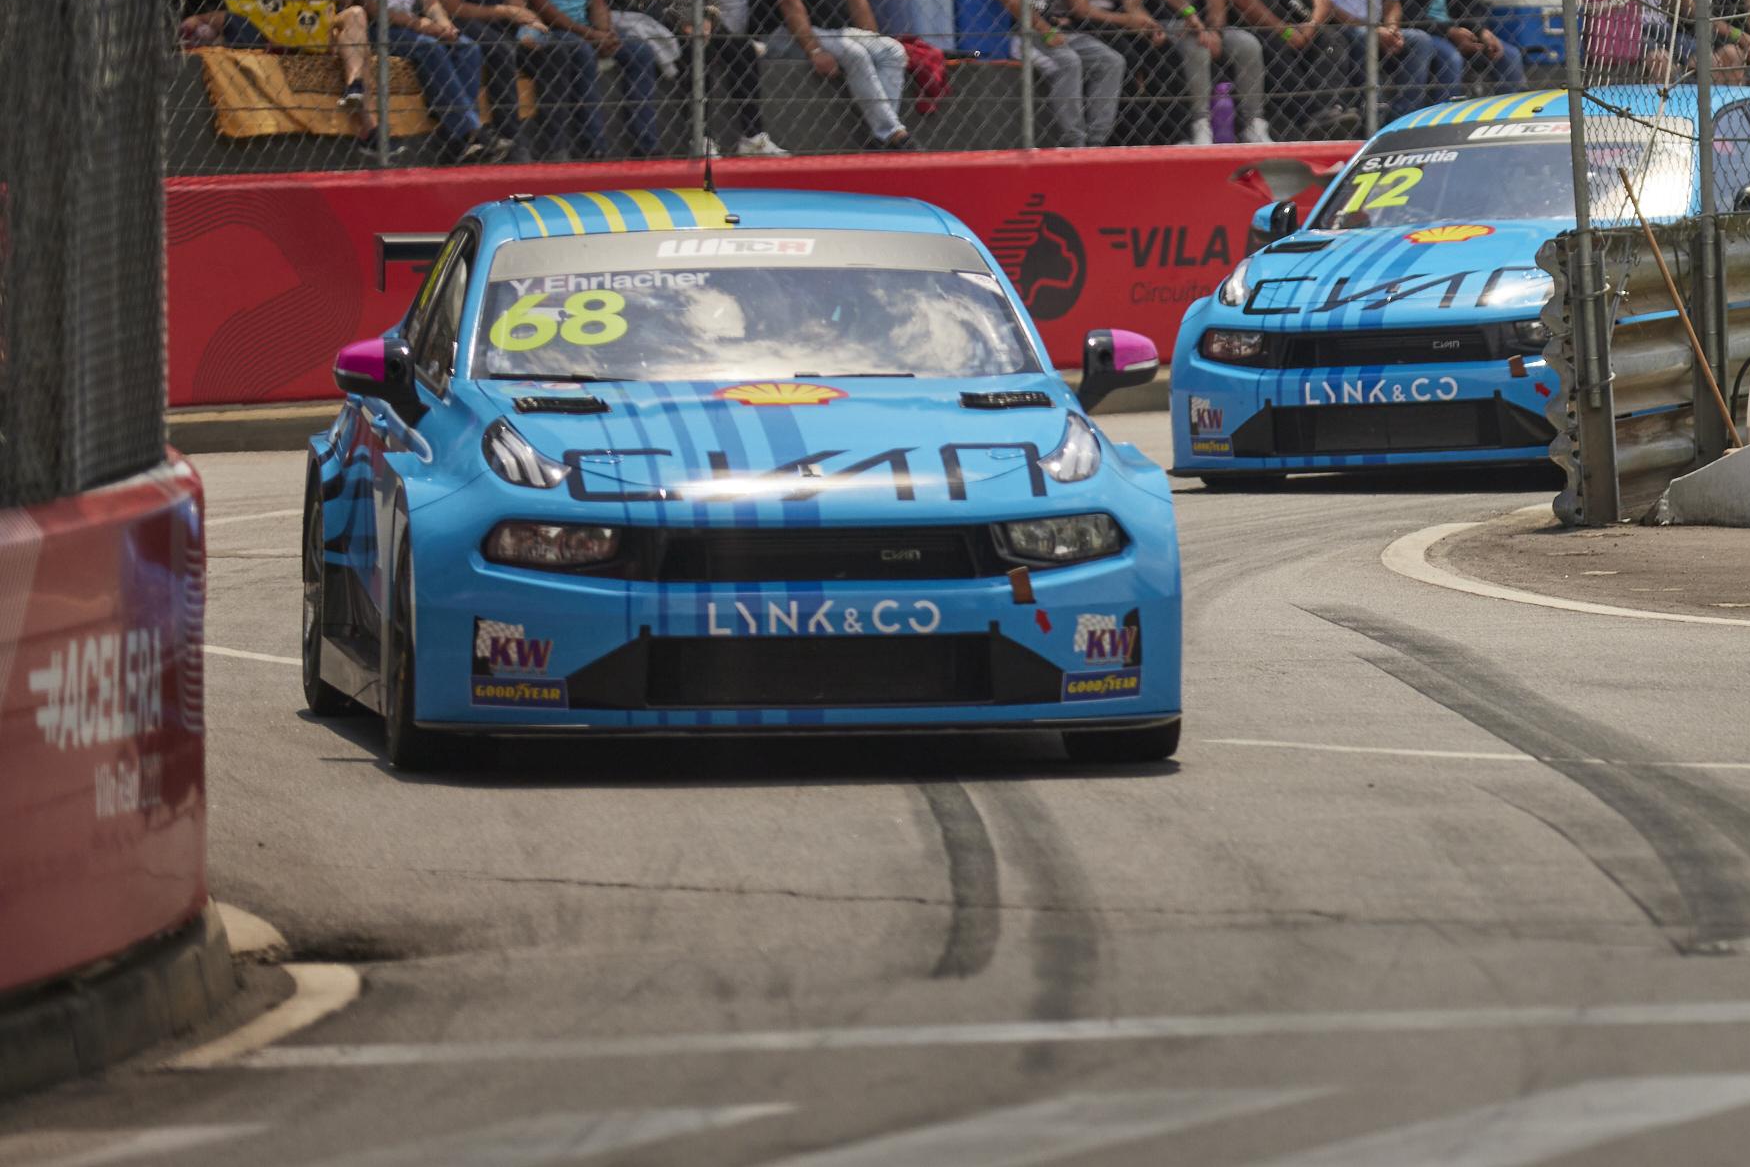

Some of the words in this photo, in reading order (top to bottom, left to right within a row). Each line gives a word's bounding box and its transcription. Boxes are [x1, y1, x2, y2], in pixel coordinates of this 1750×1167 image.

[1343, 167, 1424, 214] 12
[1130, 225, 1231, 267] VILA
[509, 270, 711, 298] Y.Ehrlacher
[489, 289, 628, 352] 68
[1196, 408, 1223, 430] KW
[490, 636, 553, 669] KW
[1086, 626, 1138, 660] KW
[474, 683, 561, 701] GOODYEAR
[1067, 674, 1137, 694] GOODYEAR
